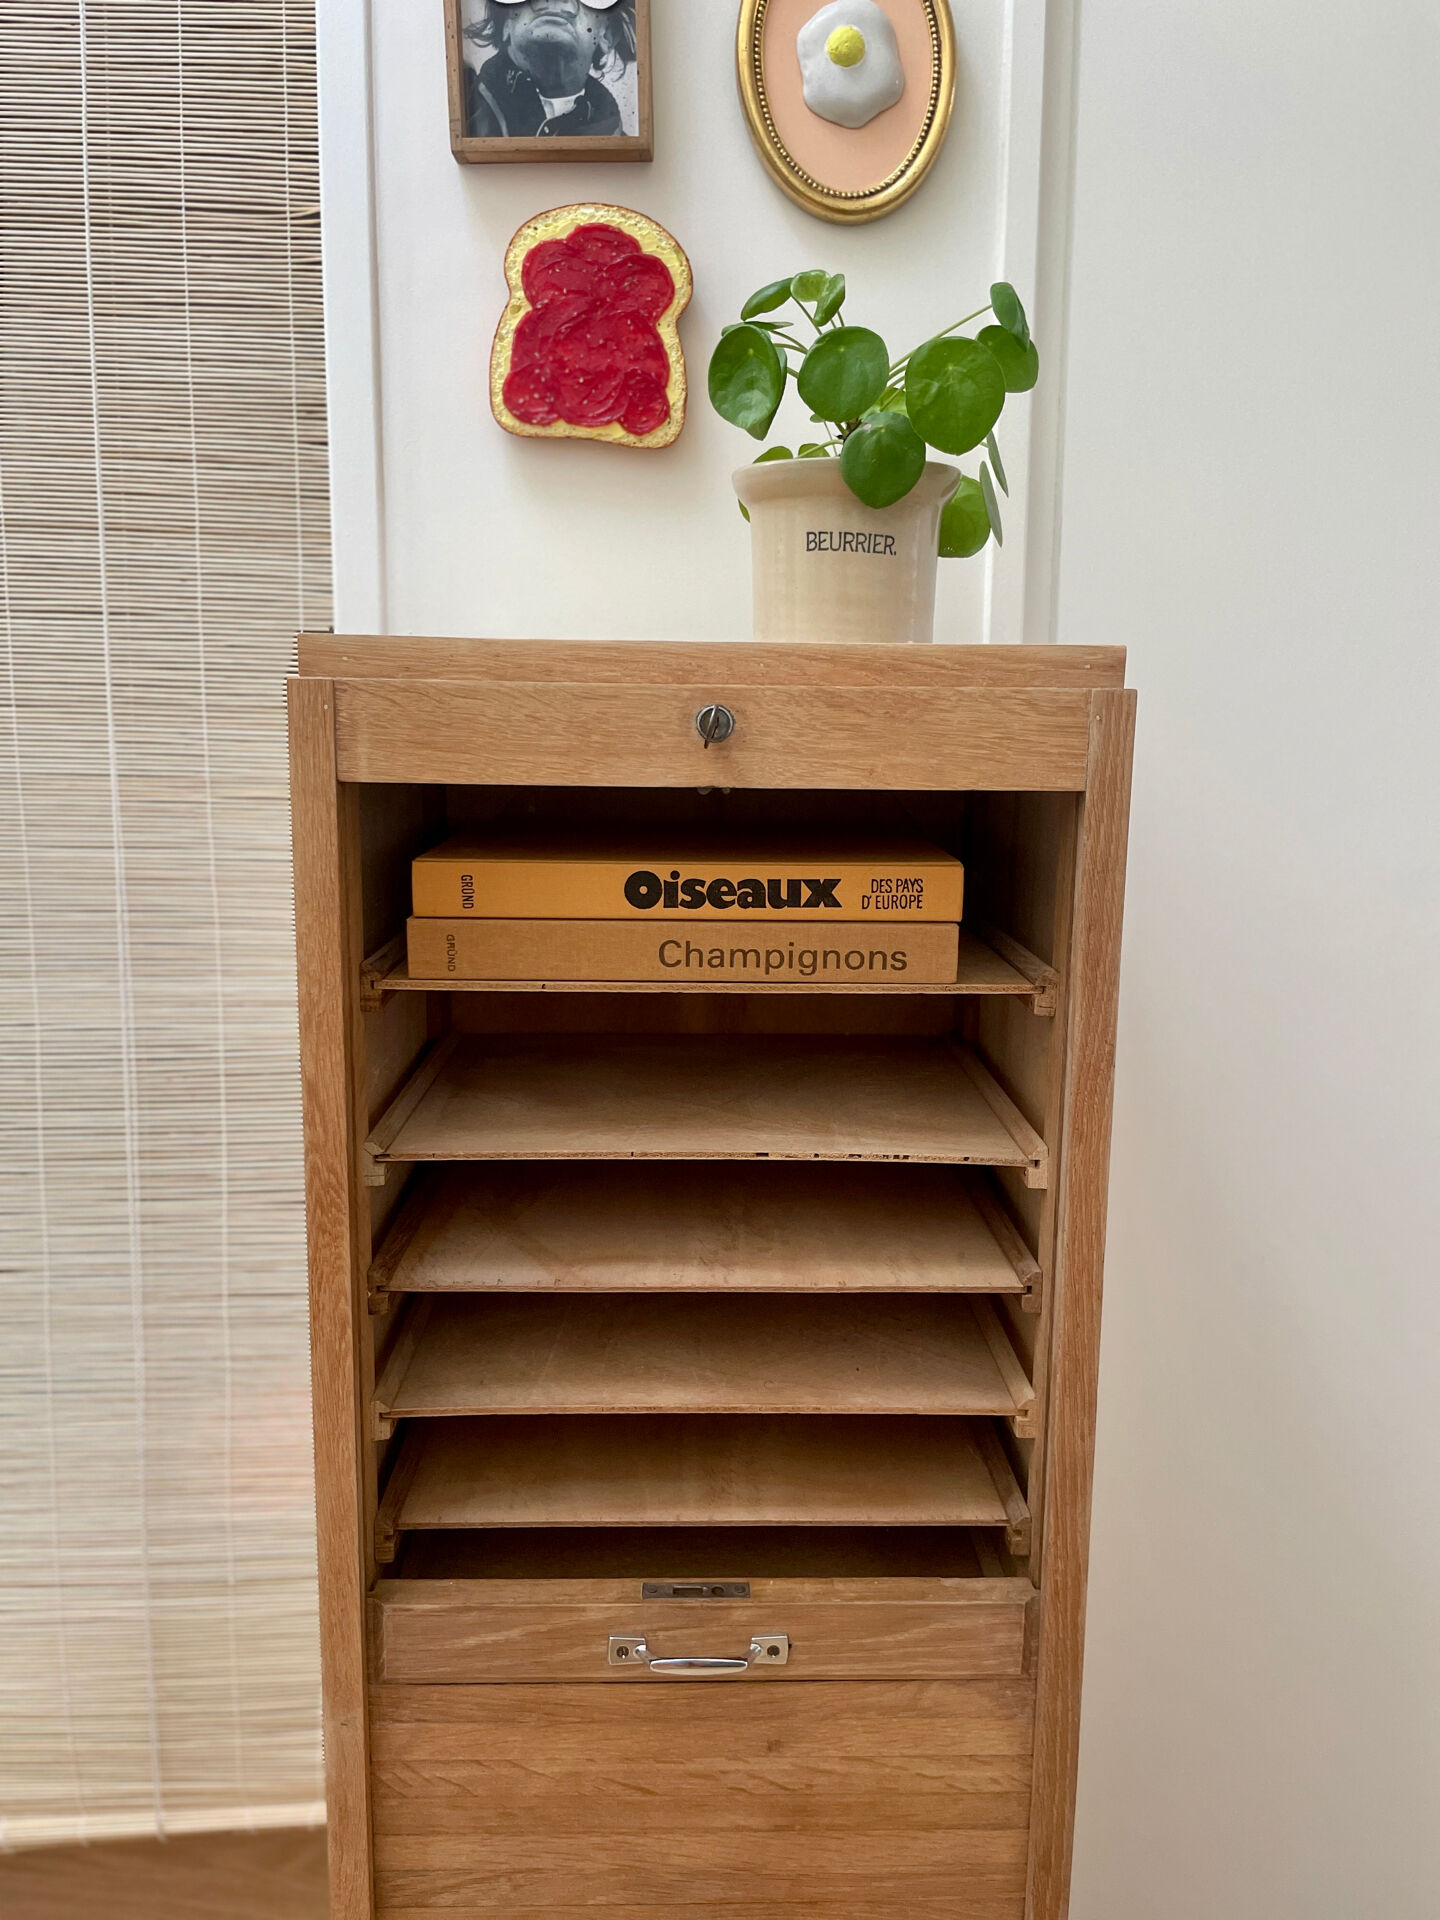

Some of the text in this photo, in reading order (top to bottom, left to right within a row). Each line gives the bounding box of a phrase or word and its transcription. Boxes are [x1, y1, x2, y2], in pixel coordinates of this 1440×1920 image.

[624, 870, 842, 909] Oiseaux
[871, 878, 924, 893] DES PAYS
[658, 939, 908, 976] Champignons
